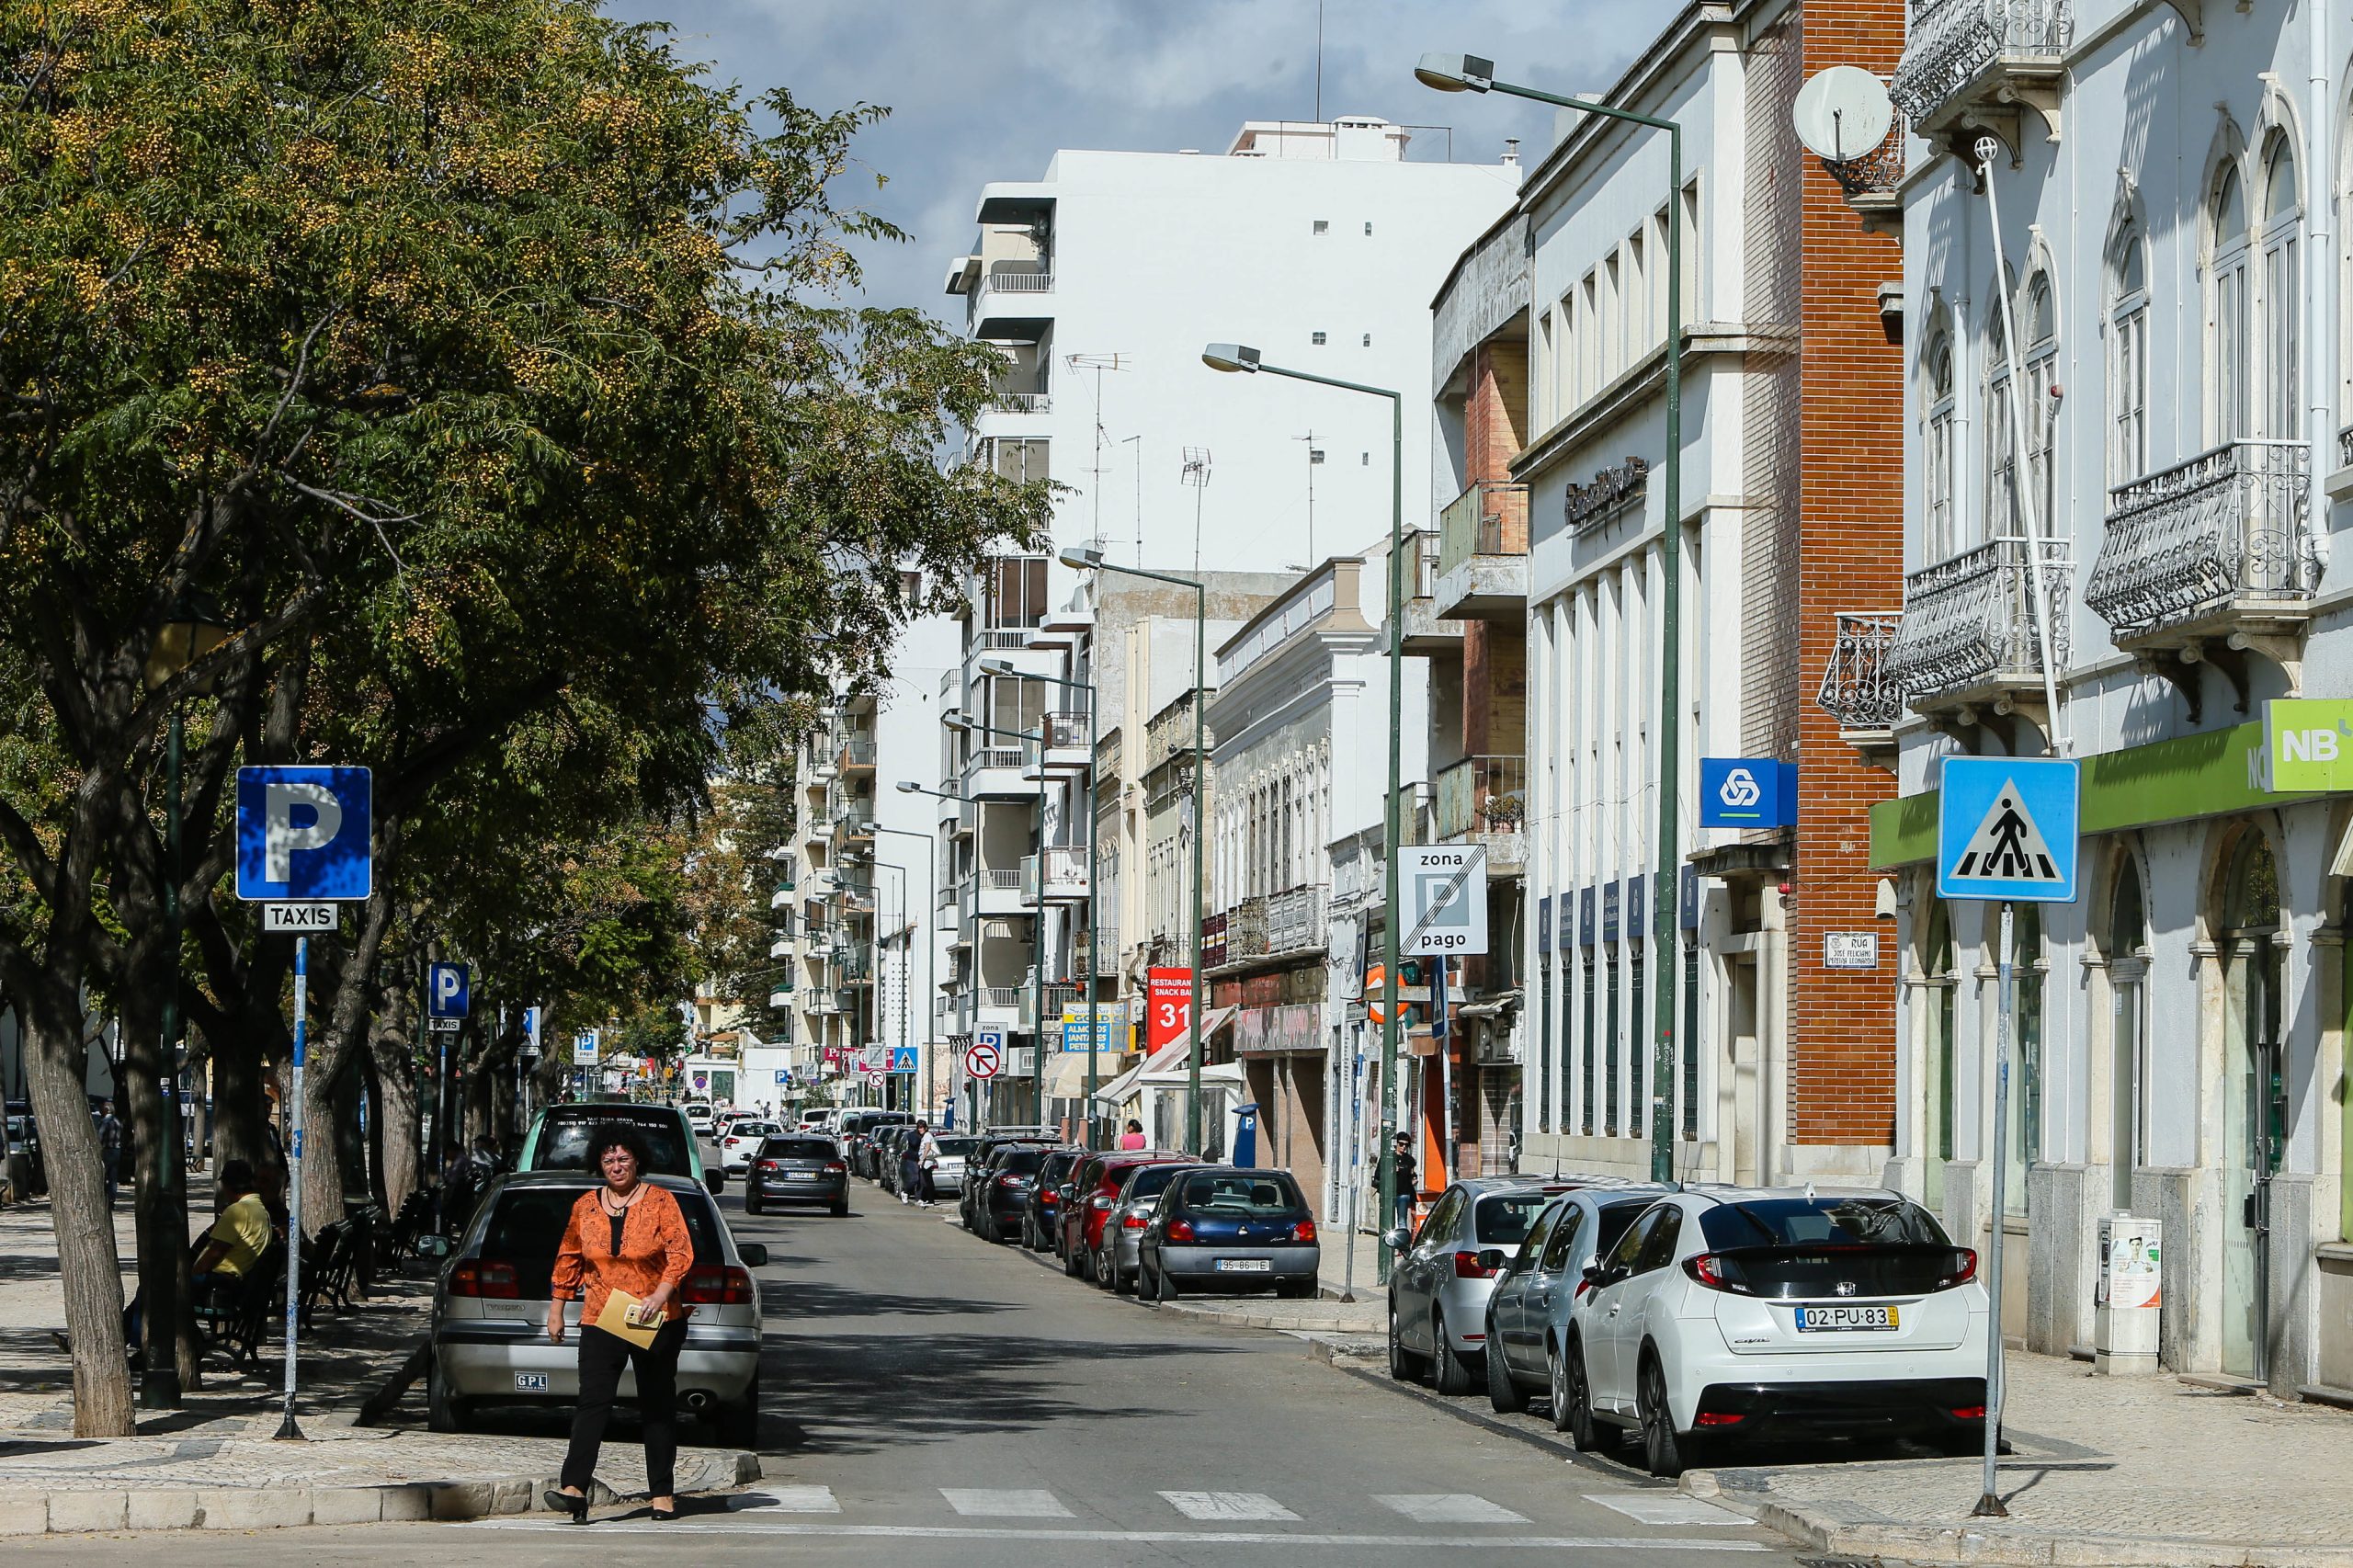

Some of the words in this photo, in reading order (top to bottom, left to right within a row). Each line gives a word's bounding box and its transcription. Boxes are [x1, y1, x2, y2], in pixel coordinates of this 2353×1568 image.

[2283, 729, 2339, 762] NB
[266, 783, 343, 882] P
[1420, 854, 1463, 866] zona
[1425, 877, 1461, 924] P
[270, 904, 332, 926] TÁXIS
[1421, 934, 1466, 949] pago
[1851, 938, 1868, 949] RUA
[1150, 978, 1192, 986] RESTAURAN
[438, 968, 460, 1011] P
[1154, 988, 1179, 996] SNACK
[1159, 1003, 1191, 1028] 31
[581, 1036, 592, 1050] P
[777, 1072, 786, 1083] P
[1245, 1117, 1254, 1130] P
[1223, 1261, 1234, 1270] 95
[1239, 1261, 1250, 1270] 86
[1256, 1261, 1267, 1270] IE
[517, 1375, 545, 1387] GPL
